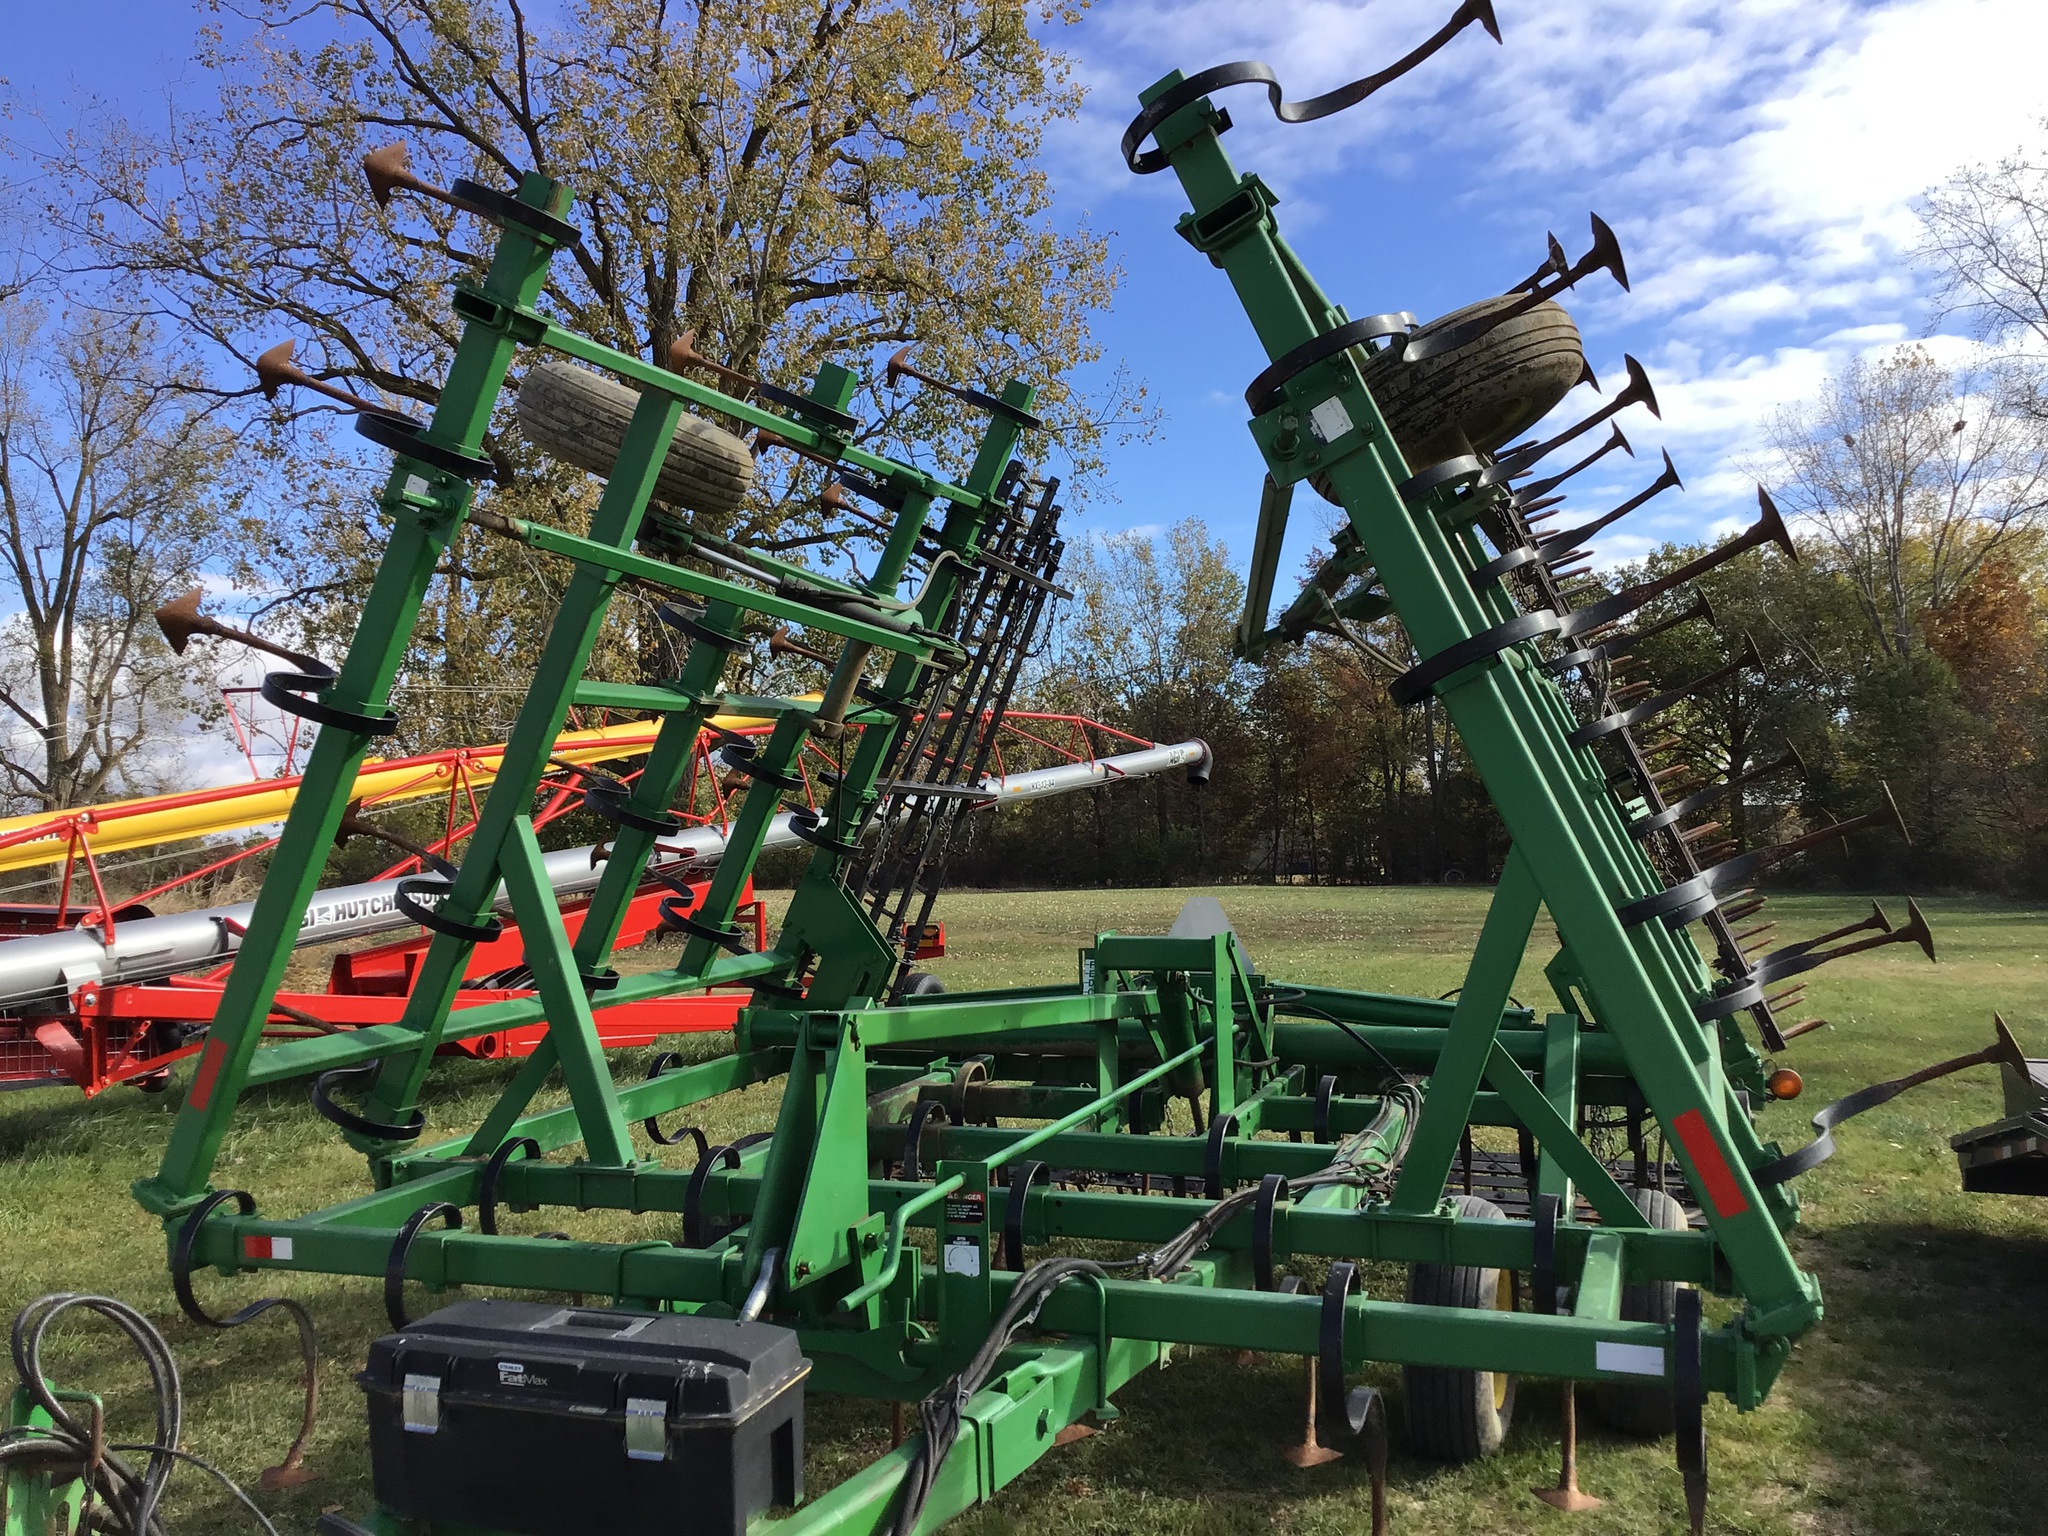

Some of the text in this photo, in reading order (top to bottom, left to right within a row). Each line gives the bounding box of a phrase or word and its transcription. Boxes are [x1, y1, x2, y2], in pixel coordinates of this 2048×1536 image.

[1088, 979, 1095, 987] D
[954, 1193, 982, 1201] DNGER
[499, 1371, 548, 1386] FatMax
